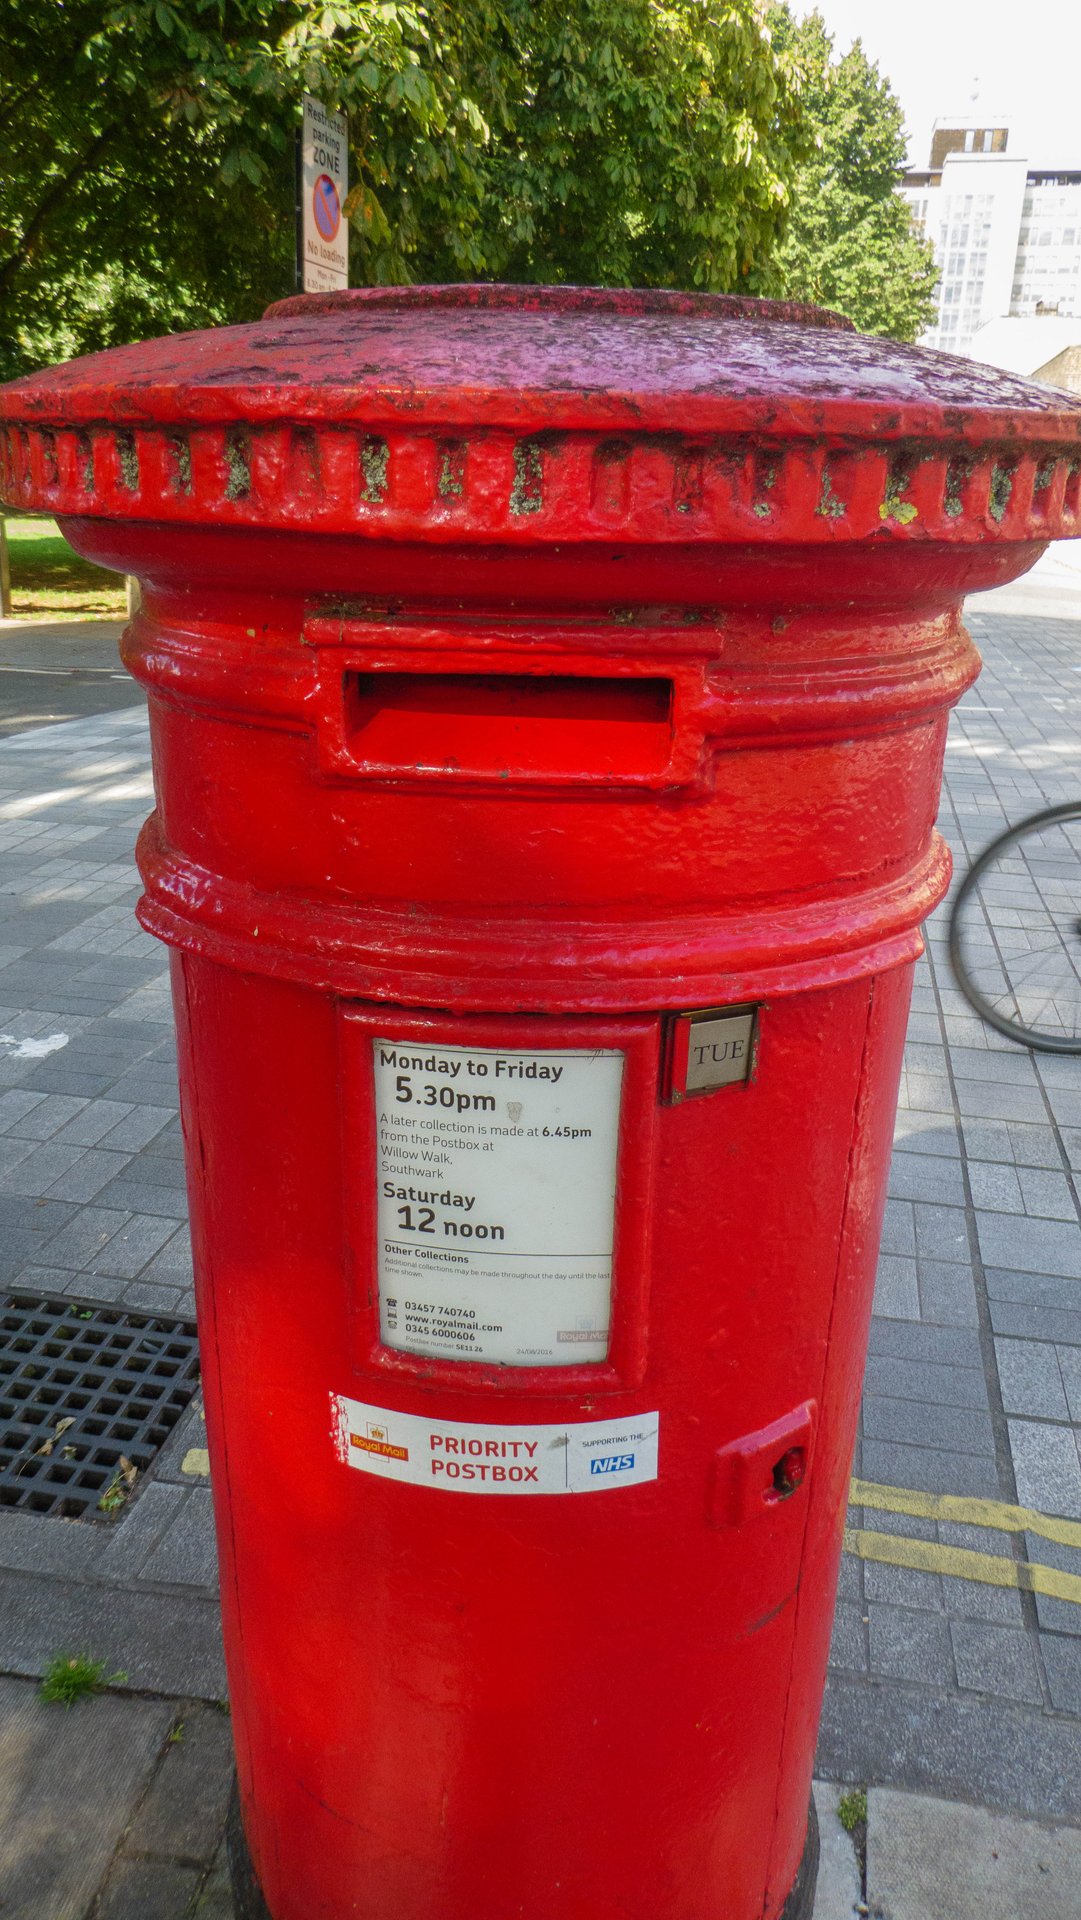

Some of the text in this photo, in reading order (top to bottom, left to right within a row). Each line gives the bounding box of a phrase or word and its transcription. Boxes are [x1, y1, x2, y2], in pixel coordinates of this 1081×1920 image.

[312, 128, 340, 153] parking
[313, 146, 340, 174] ZONE
[307, 239, 346, 269] No loading
[694, 1039, 745, 1065] TUE
[380, 1050, 563, 1083] Monday to Friday
[395, 1076, 496, 1113] 5.30pm
[380, 1113, 592, 1139] A later collection is made at 6.45pm
[381, 1129, 495, 1152] from the Postbox at
[381, 1145, 453, 1165] Willow Walk,
[381, 1161, 444, 1179] Southwark
[383, 1182, 476, 1211] Saturday
[397, 1205, 505, 1241] 12 noon
[385, 1244, 469, 1264] Other Collections
[384, 1257, 417, 1269] Additional
[418, 1263, 453, 1274] collections
[501, 1271, 540, 1280] throughout
[385, 1266, 424, 1278] time shown.
[405, 1301, 475, 1318] 03457 740740
[405, 1314, 503, 1332] www.royalmail.com
[405, 1323, 475, 1341] 0345 6000606
[430, 1340, 454, 1348] number
[560, 1332, 587, 1341] Royal
[352, 1435, 405, 1457] Royal Mail
[430, 1434, 538, 1458] PRIORITY
[582, 1436, 628, 1447] SUPPORTING
[432, 1460, 538, 1482] POSTBOX
[592, 1454, 633, 1473] NHS
